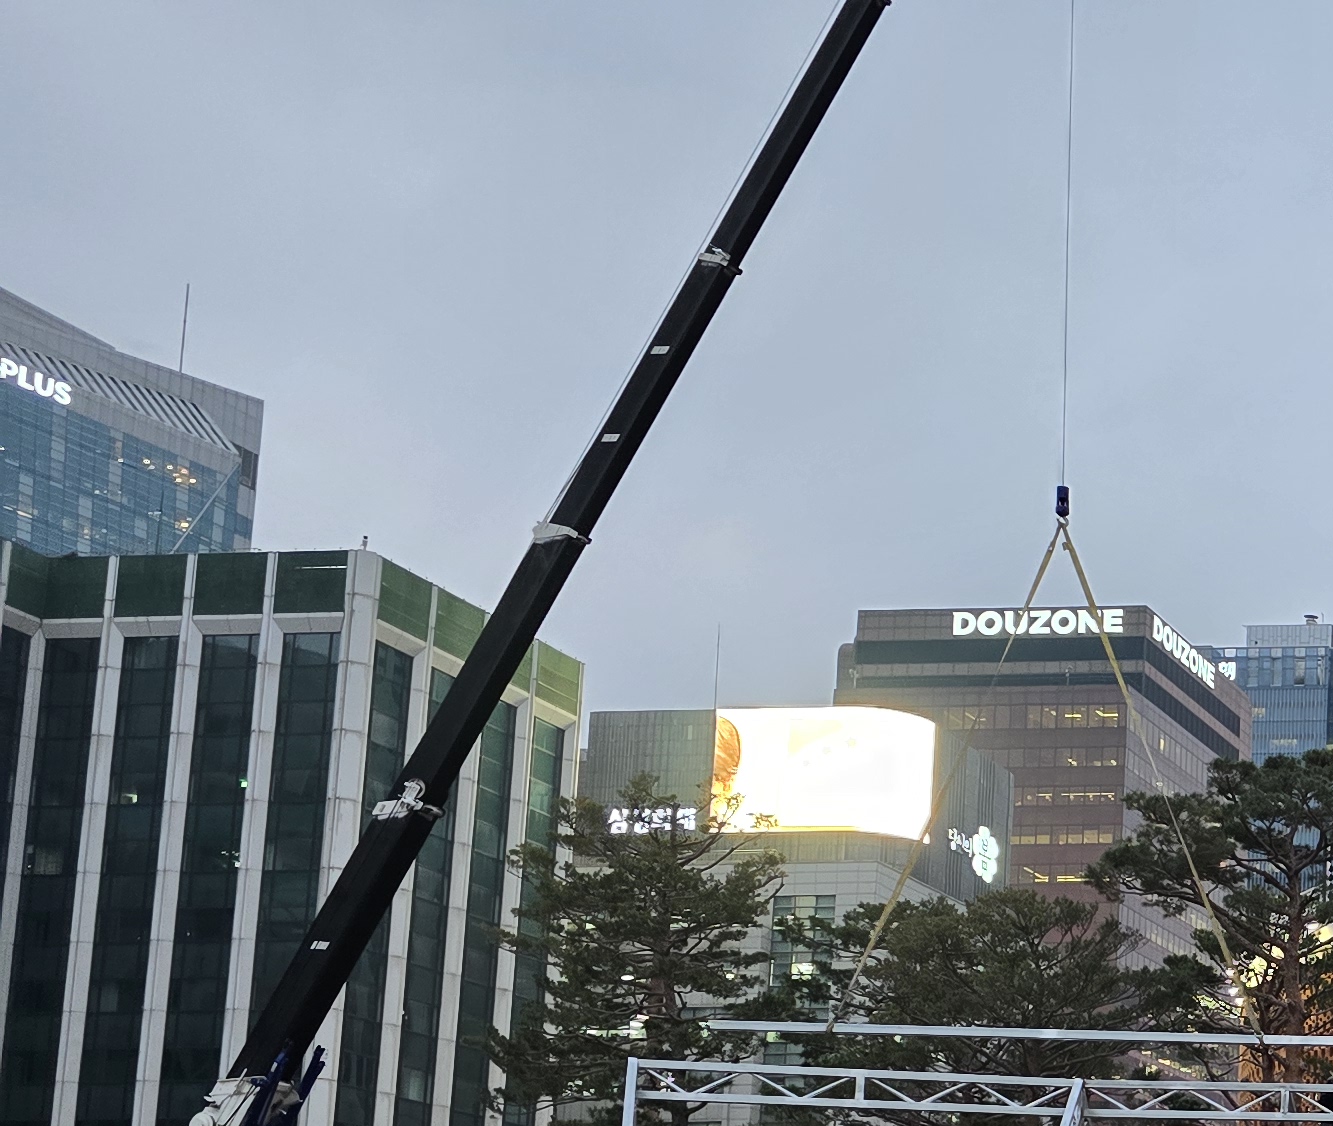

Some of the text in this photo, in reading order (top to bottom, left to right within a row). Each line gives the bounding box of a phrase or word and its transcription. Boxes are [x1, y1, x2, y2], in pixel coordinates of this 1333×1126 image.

[0, 357, 72, 406] PLUS
[952, 608, 1124, 636] DOUZONE
[1151, 614, 1216, 690] DOUZONE
